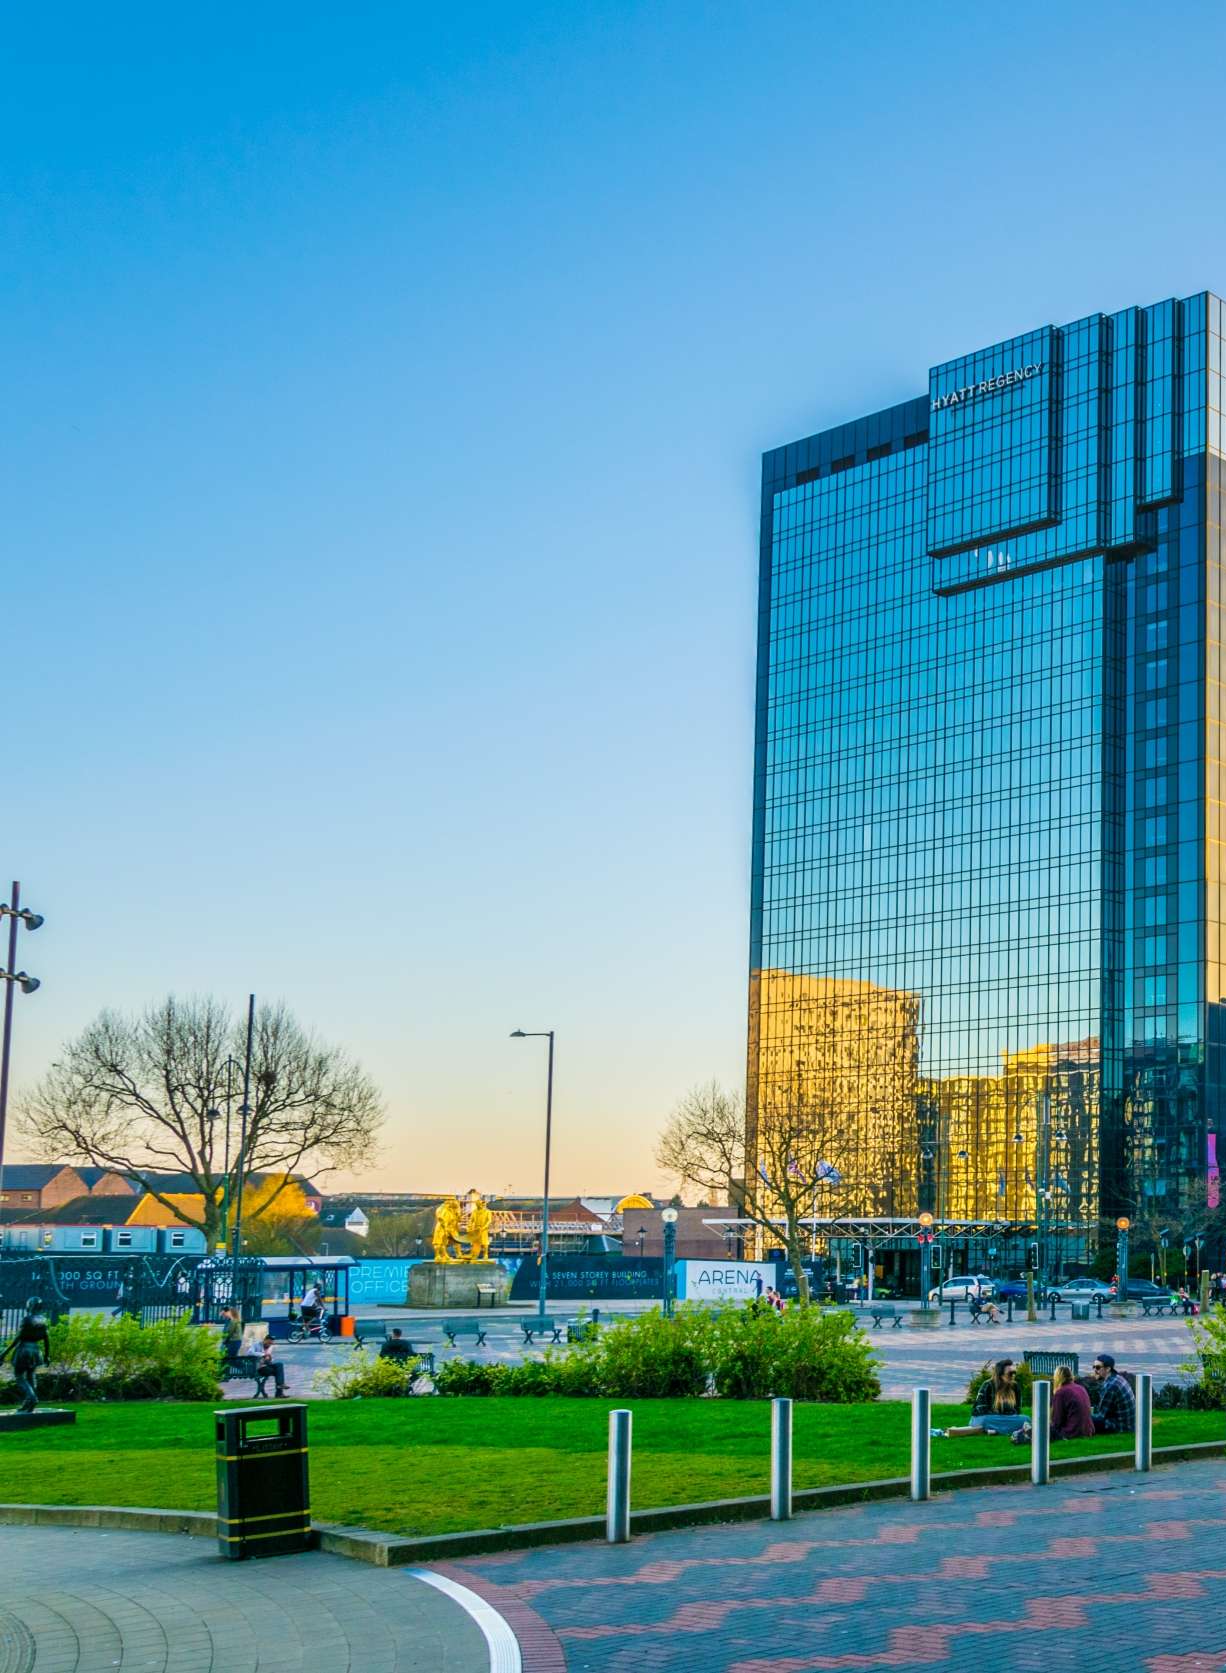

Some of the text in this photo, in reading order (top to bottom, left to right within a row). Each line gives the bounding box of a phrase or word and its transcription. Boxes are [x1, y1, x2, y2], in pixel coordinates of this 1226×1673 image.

[932, 362, 1042, 410] HYATT REGENCY
[86, 1271, 102, 1280] SQ
[107, 1271, 119, 1280] FT
[552, 1271, 578, 1280] SEVEN
[580, 1271, 609, 1279] STOREY
[612, 1270, 647, 1279] BUILDING
[698, 1269, 760, 1285] ARENA
